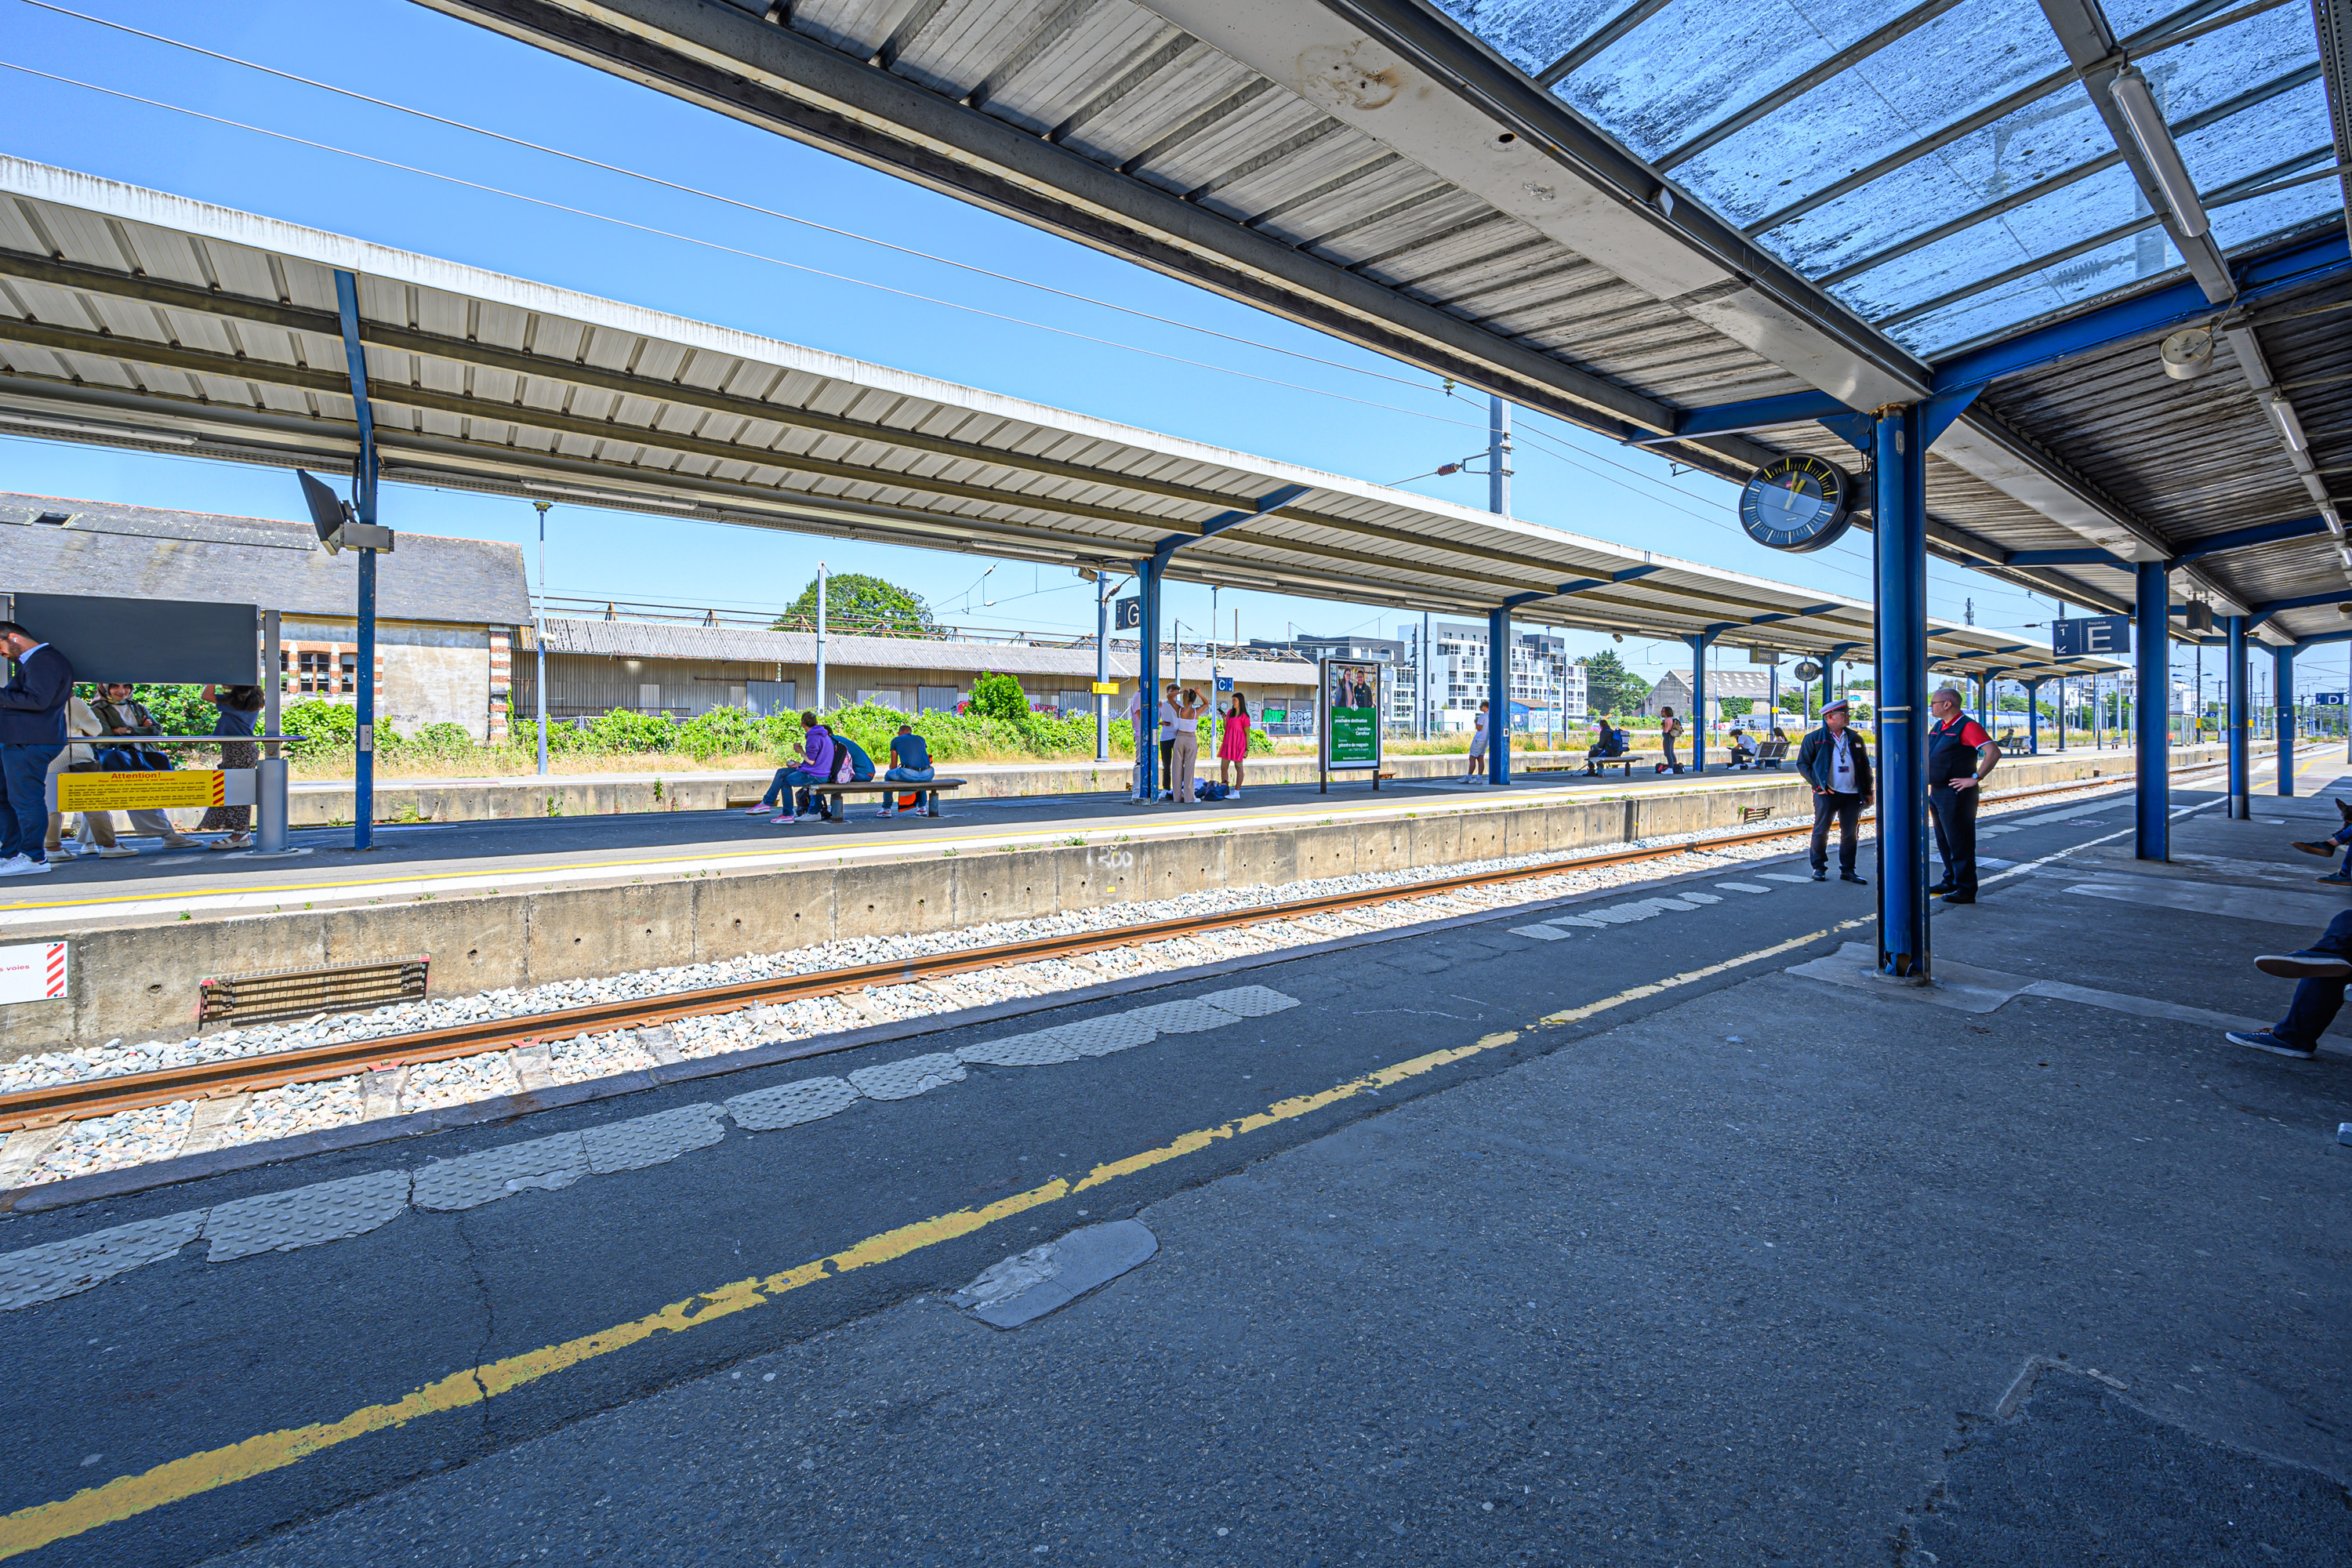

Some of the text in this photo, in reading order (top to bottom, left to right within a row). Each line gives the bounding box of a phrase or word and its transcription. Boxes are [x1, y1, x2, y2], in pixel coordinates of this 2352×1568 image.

[1127, 603, 1139, 626] G
[2087, 625, 2112, 652] E
[1218, 680, 1225, 691] C
[2328, 695, 2339, 705] D
